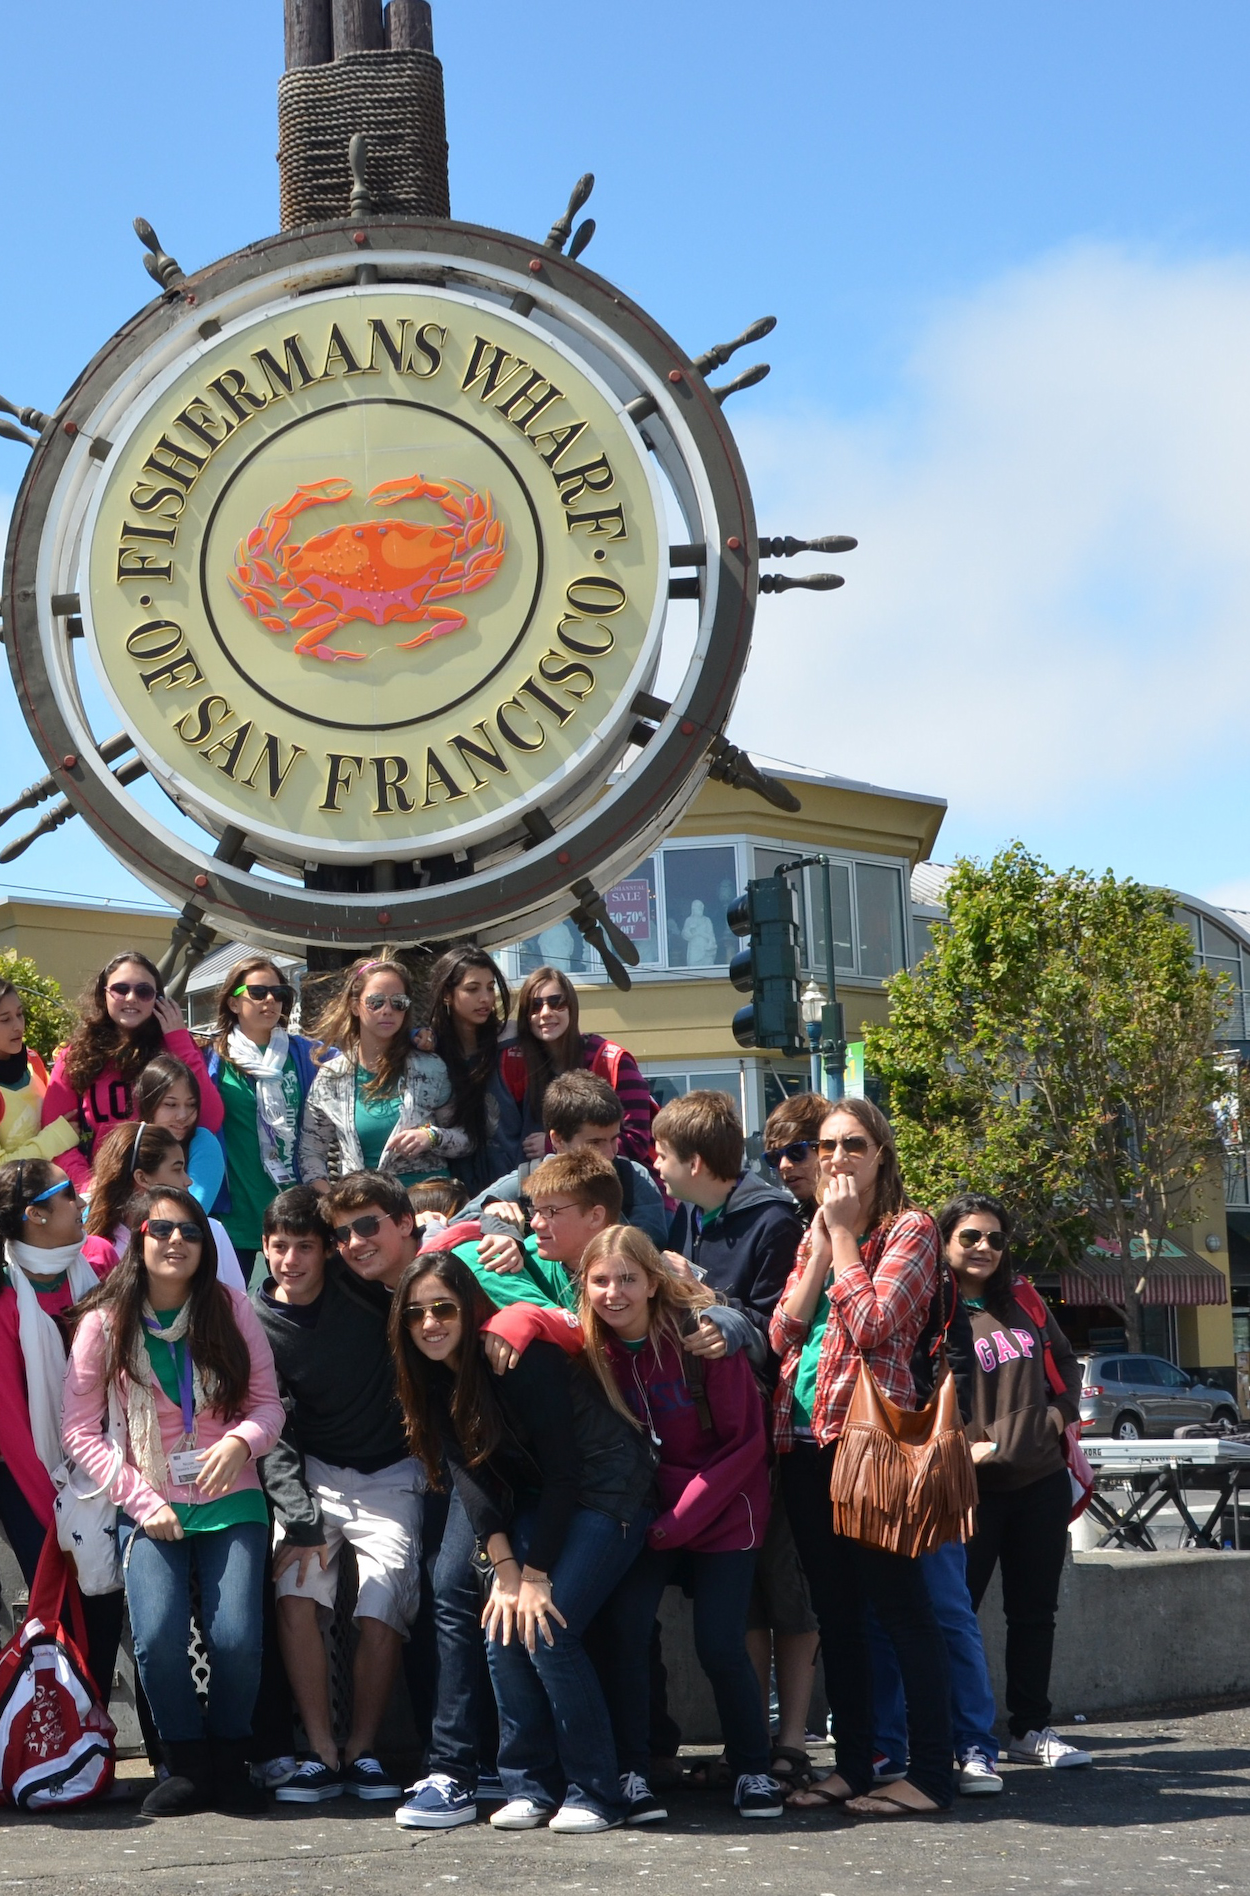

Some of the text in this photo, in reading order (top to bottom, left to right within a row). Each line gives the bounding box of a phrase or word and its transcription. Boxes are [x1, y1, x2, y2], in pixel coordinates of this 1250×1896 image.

[116, 318, 628, 585] FISHERMANS WHARF
[125, 575, 627, 816] OF SAN FRANCISCO
[611, 891, 641, 902] SALE
[974, 1328, 1035, 1373] GAP
[1083, 1448, 1102, 1457] KORG
